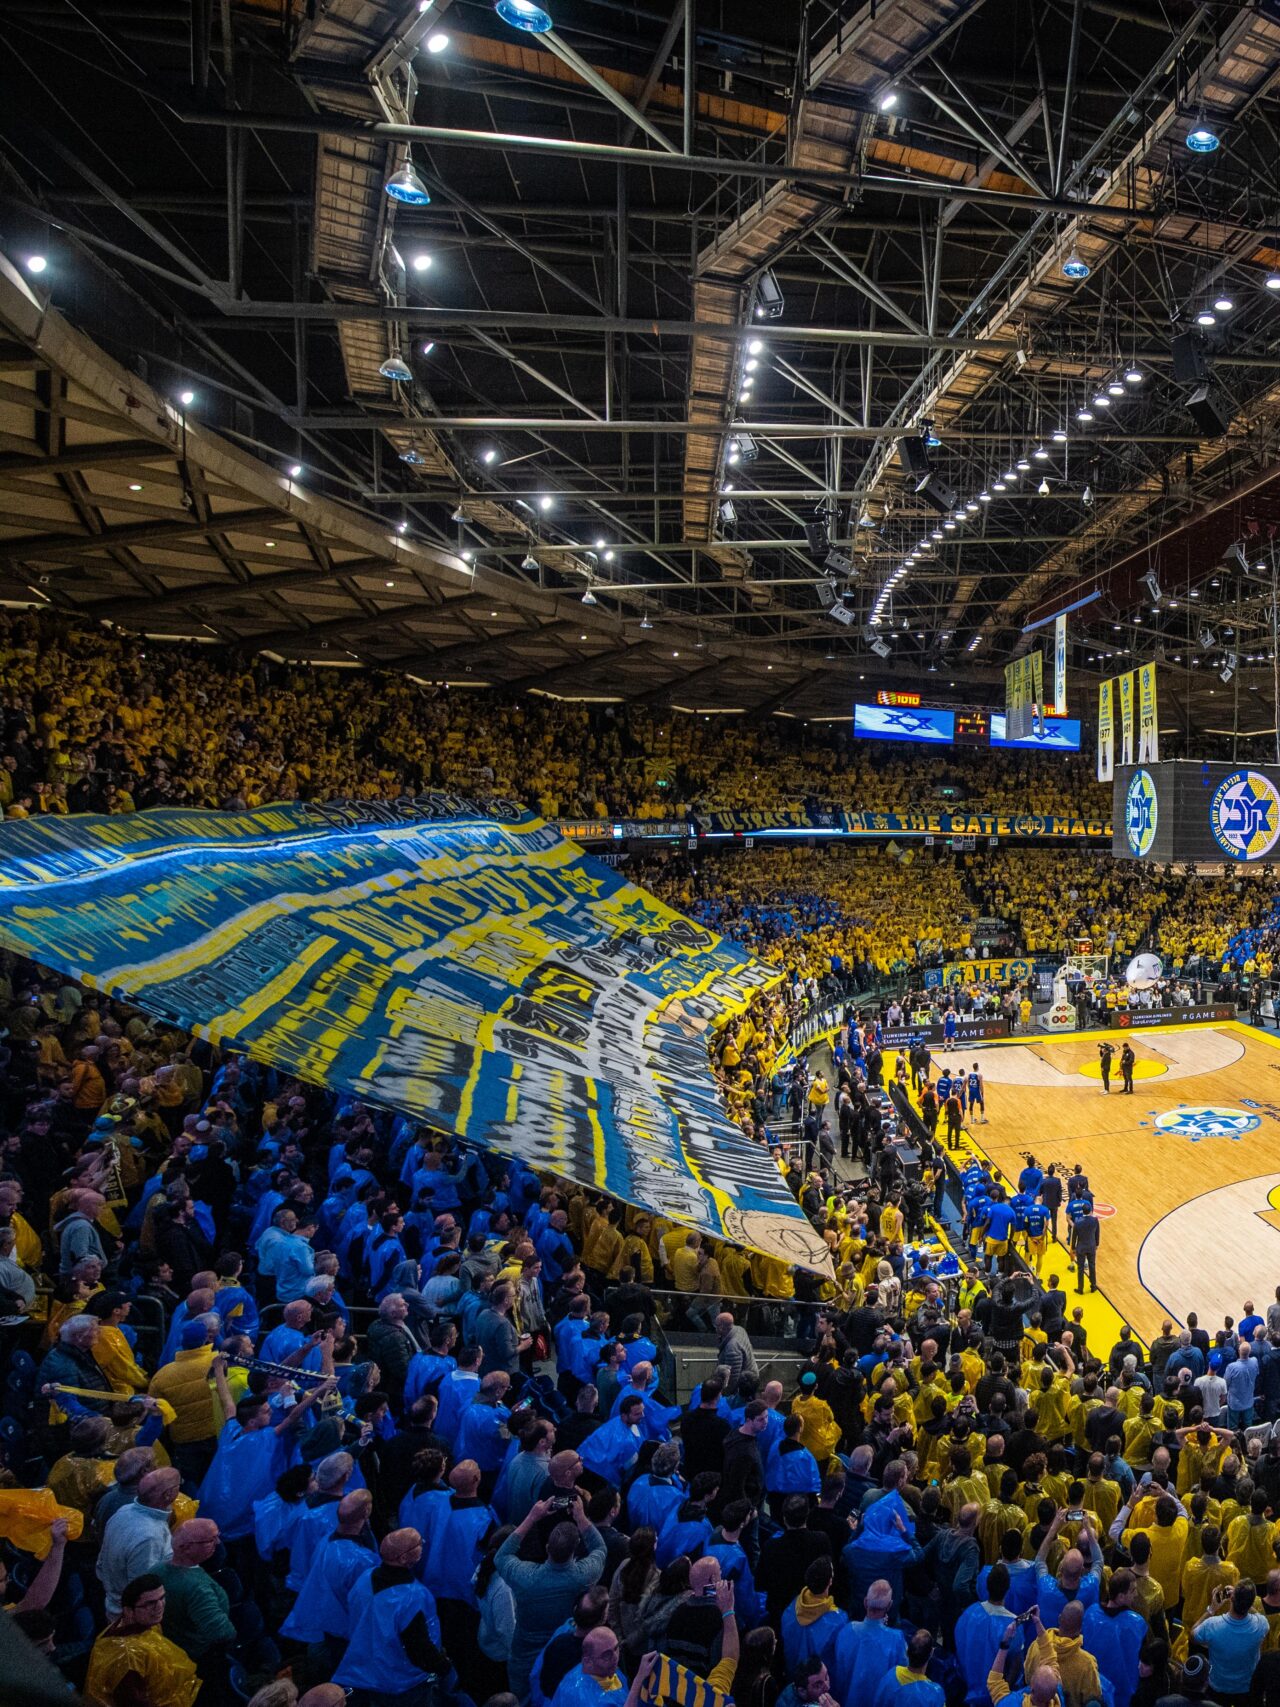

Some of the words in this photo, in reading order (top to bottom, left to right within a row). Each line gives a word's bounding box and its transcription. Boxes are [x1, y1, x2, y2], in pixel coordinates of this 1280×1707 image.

[716, 811, 785, 831] ULTRAS
[790, 812, 813, 828] 96
[895, 815, 942, 831] THE
[951, 816, 1012, 834] GATE
[1218, 836, 1241, 857] MACCABI
[969, 1078, 977, 1086] 22
[885, 1221, 892, 1230] 15
